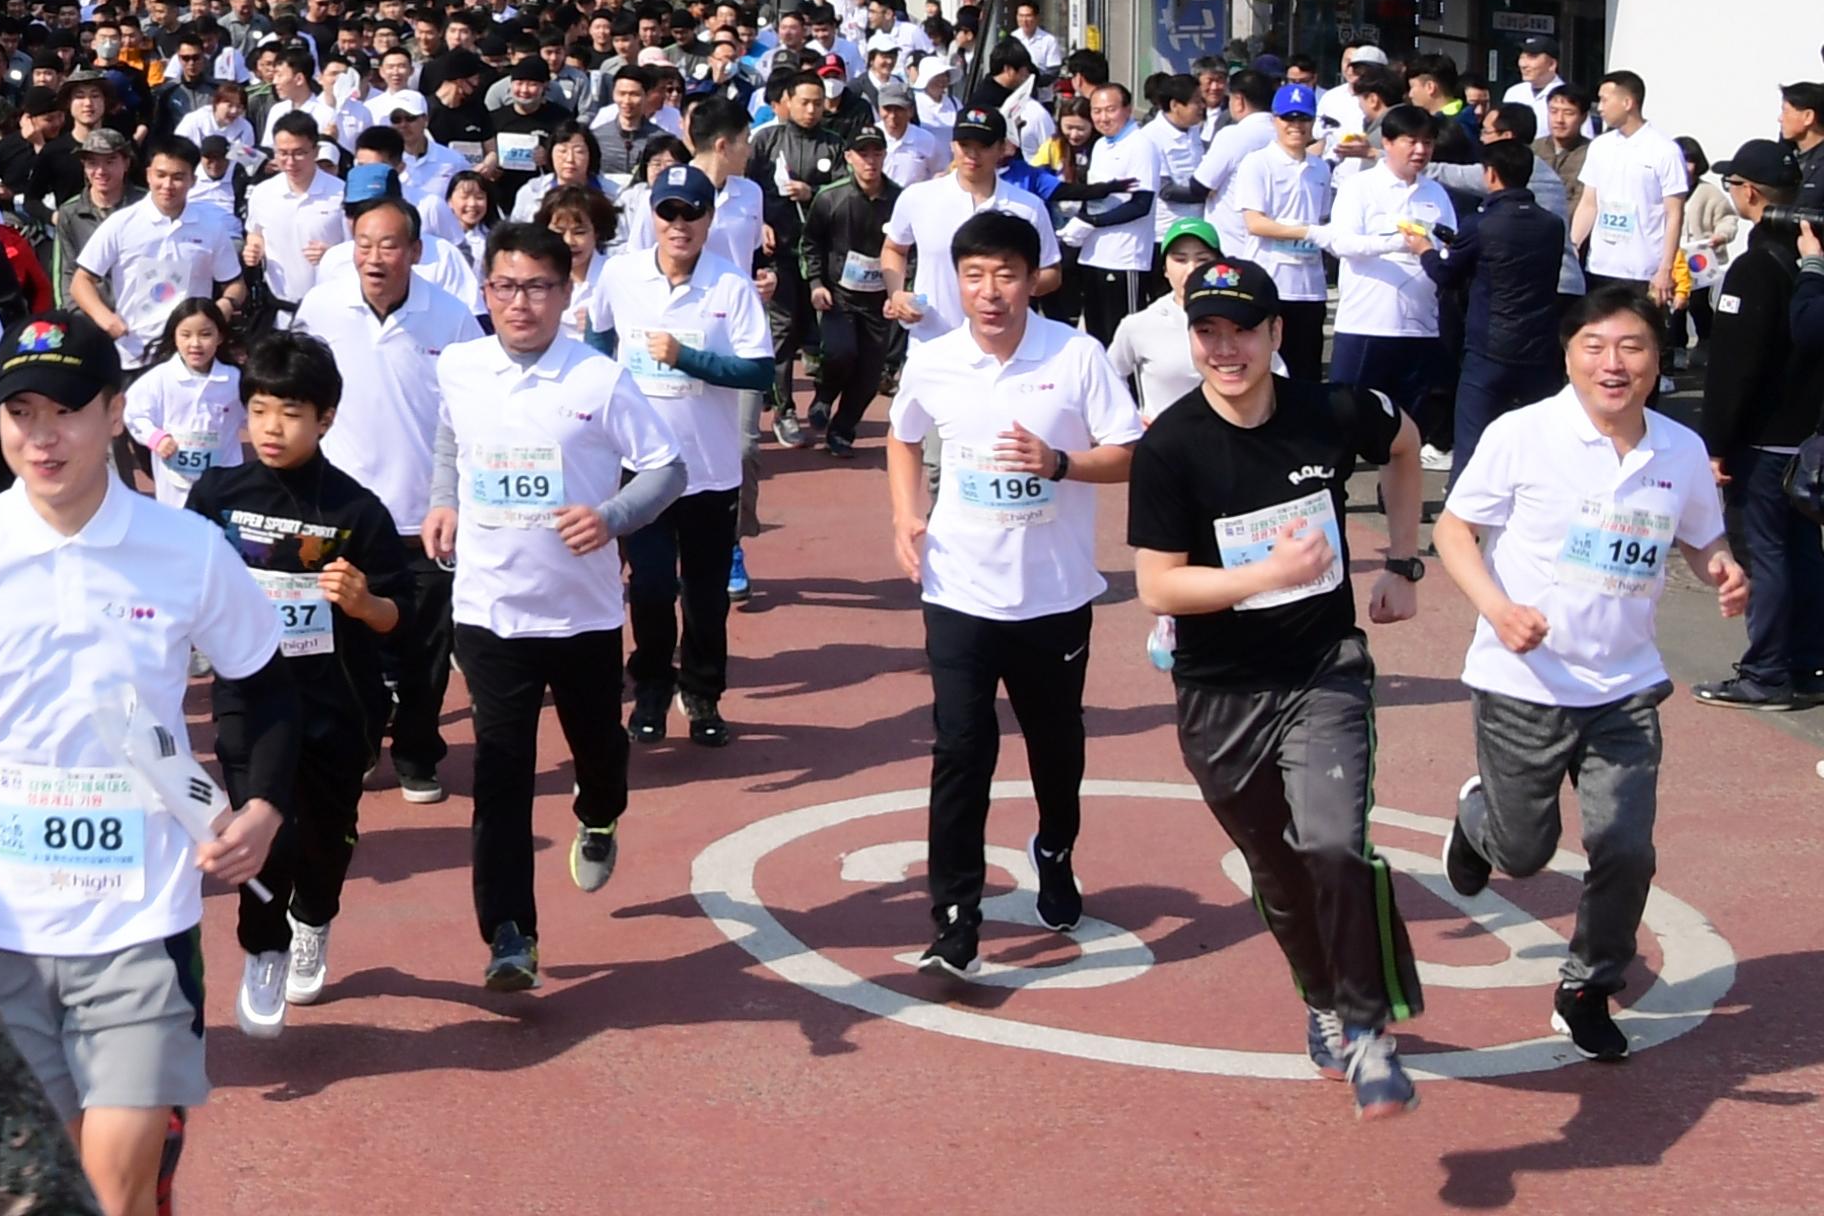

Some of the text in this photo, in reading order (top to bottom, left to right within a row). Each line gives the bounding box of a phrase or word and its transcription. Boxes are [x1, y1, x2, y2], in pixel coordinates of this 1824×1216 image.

[177, 450, 213, 469] 551
[497, 474, 550, 498] 169
[989, 476, 1042, 500] 196
[1608, 538, 1658, 568] 194
[43, 816, 124, 851] 808
